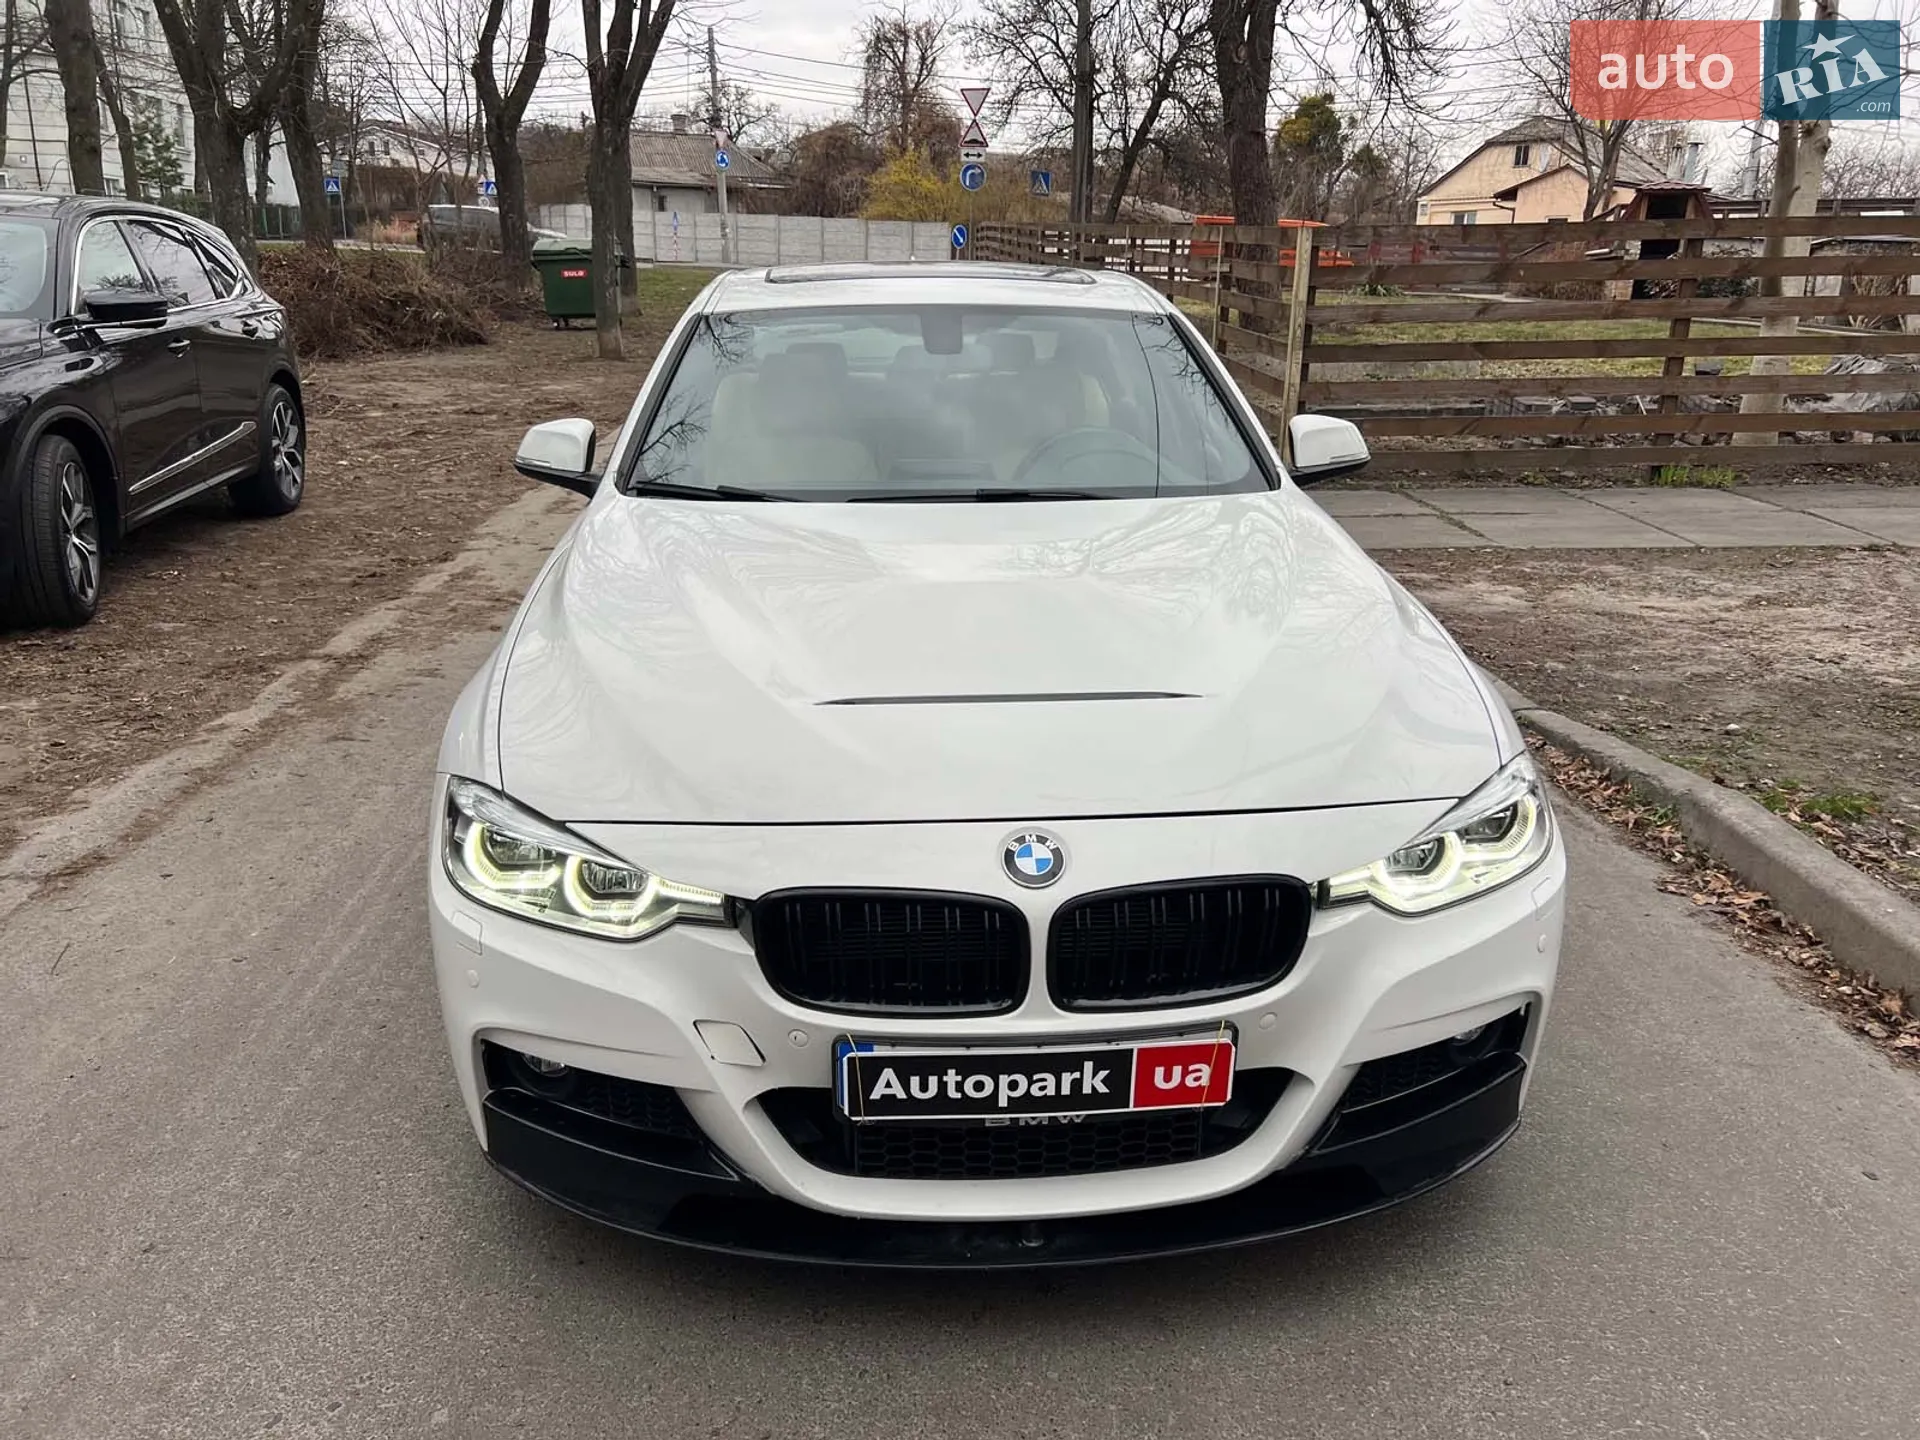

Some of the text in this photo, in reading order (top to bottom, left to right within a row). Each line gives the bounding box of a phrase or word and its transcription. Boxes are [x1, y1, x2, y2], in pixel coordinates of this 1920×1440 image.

[1008, 834, 1057, 852] BMW
[869, 1061, 1211, 1107] Autopark ua
